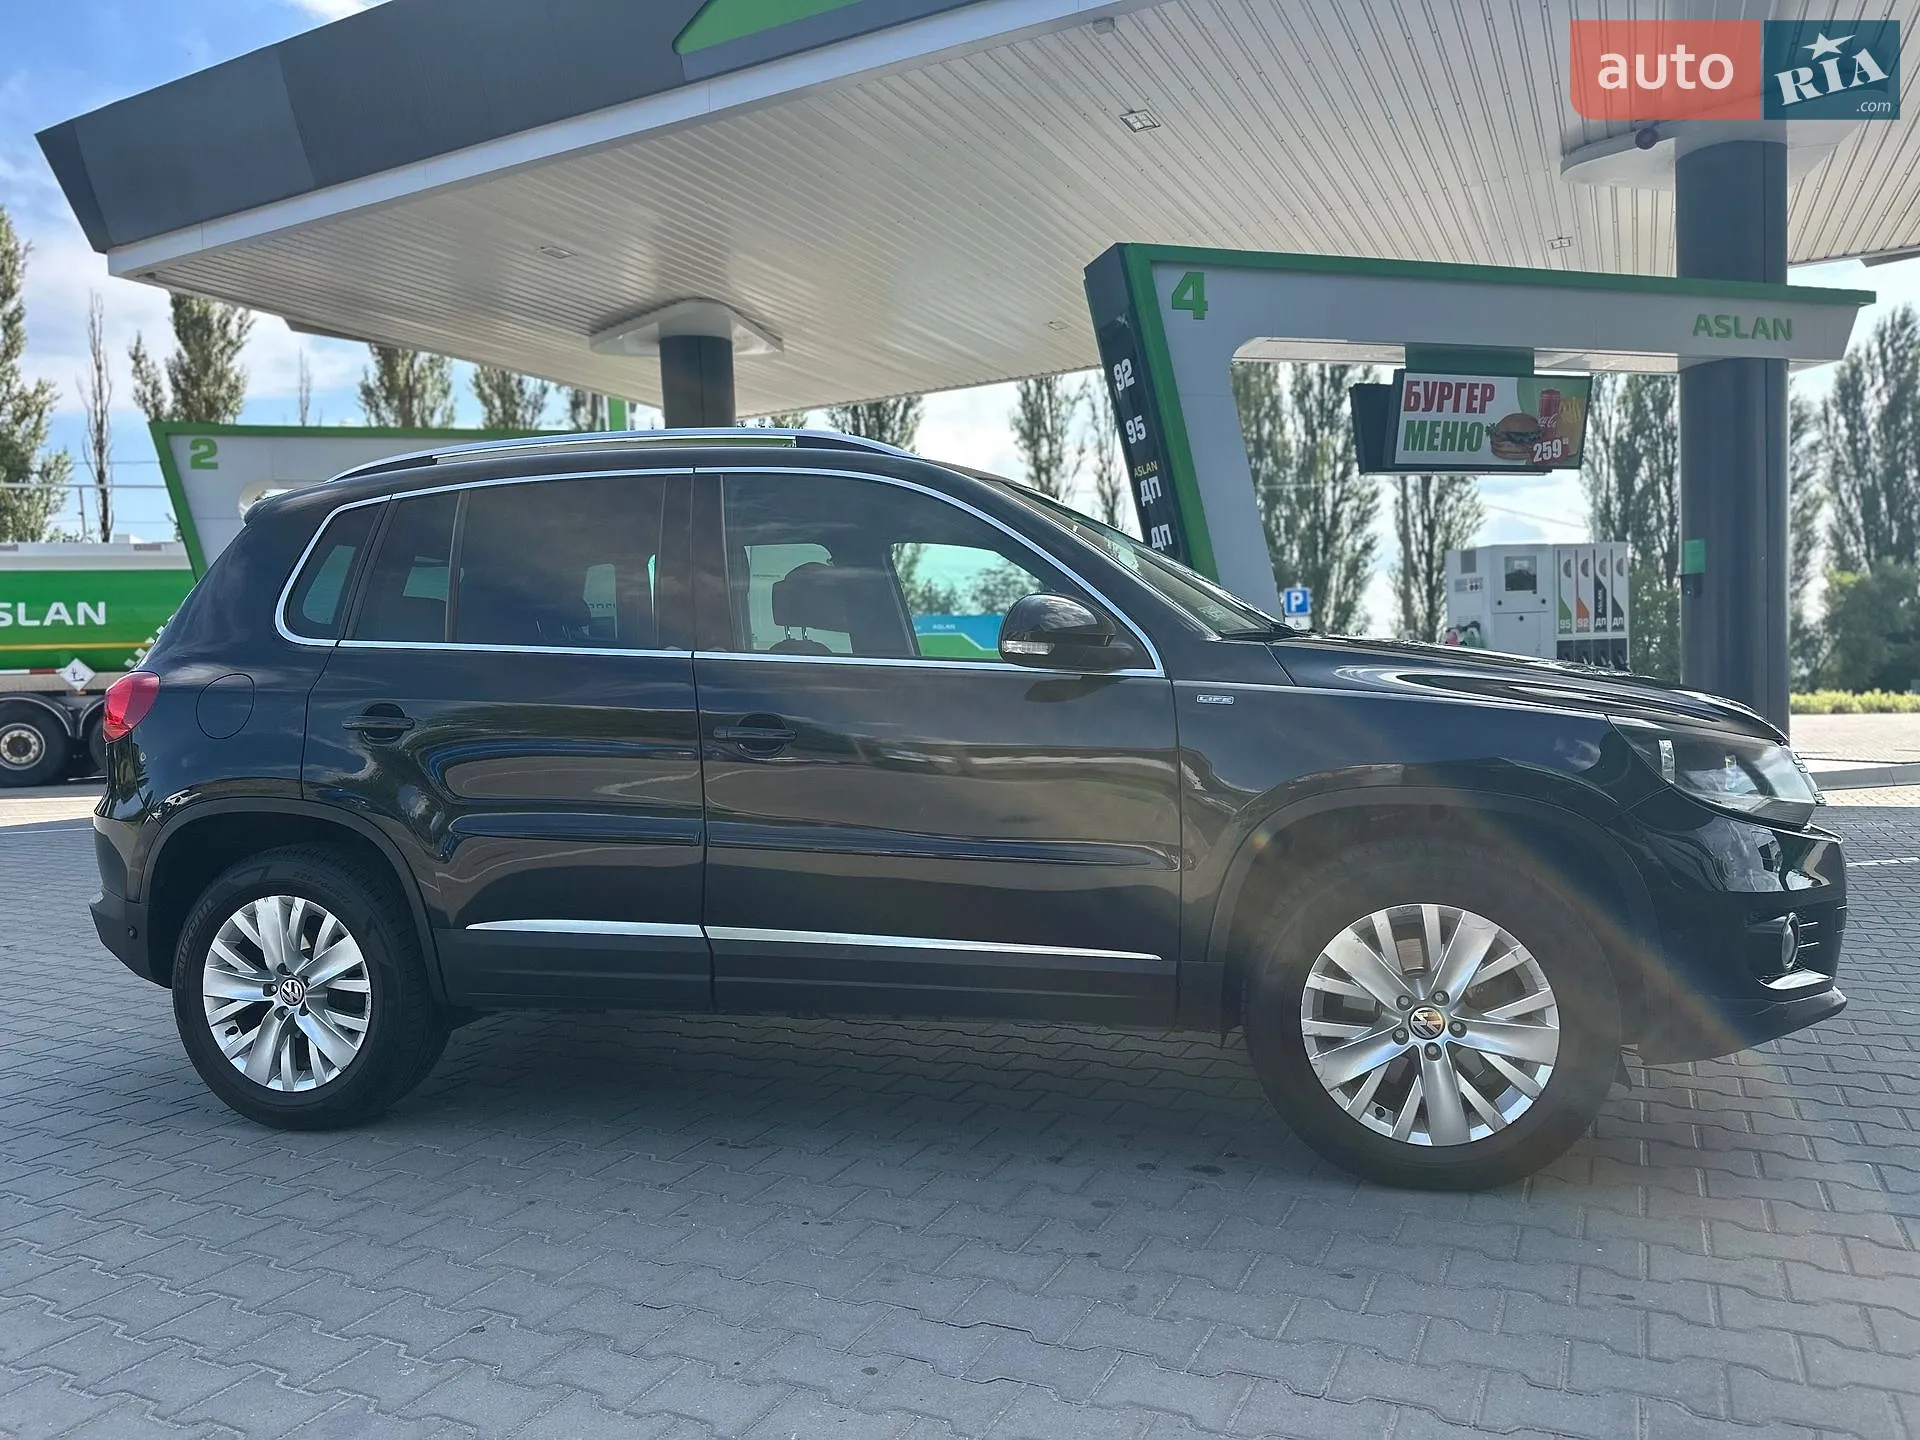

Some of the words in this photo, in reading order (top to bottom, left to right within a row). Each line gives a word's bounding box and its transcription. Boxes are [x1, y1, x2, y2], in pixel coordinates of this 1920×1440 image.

[1171, 272, 1208, 320] 4
[1692, 313, 1793, 341] ASLAN
[1113, 358, 1135, 391] 92
[1403, 380, 1496, 414] БУРГЕР
[1126, 415, 1147, 445] 95
[1403, 420, 1484, 452] МЕНЮ
[190, 438, 219, 470] 2
[1533, 438, 1562, 463] 259
[1133, 460, 1158, 478] ASLAN
[1140, 475, 1162, 507] ДП
[1151, 523, 1173, 552] ДП
[1559, 619, 1571, 629] 95
